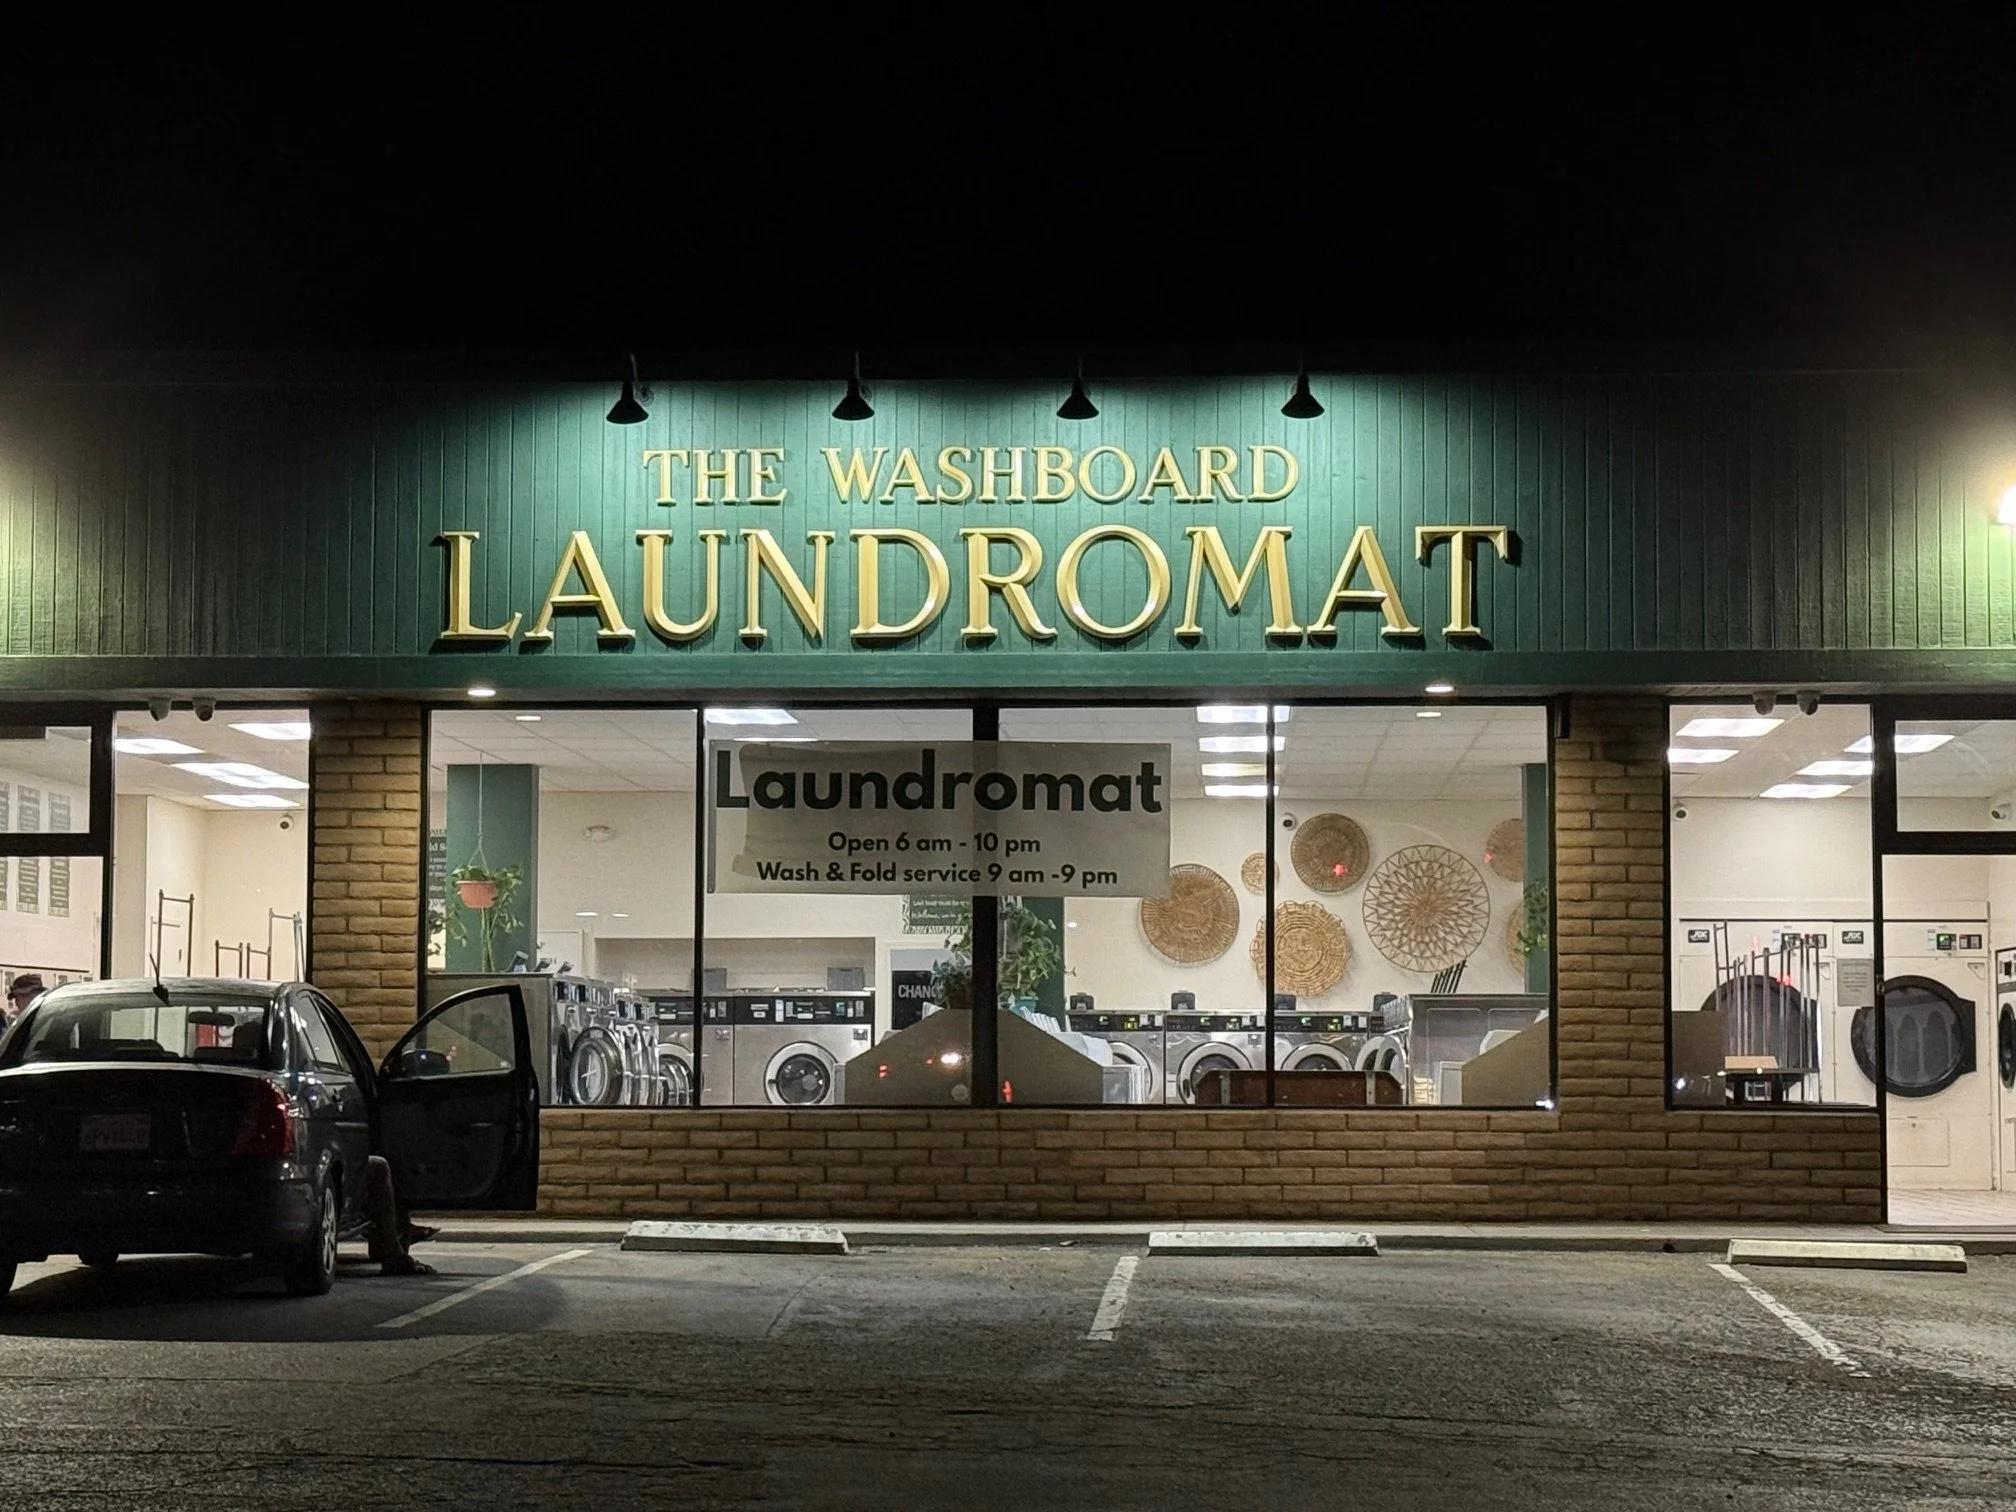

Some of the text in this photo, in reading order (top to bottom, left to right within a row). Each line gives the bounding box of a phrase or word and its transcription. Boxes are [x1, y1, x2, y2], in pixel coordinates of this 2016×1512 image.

[642, 446, 1300, 506] THE WASHBOARD
[438, 524, 1510, 642] LAUNDROMAT
[717, 749, 1163, 813] Laundromat
[828, 832, 889, 856] Open
[896, 832, 910, 851] 6
[917, 838, 952, 851] am
[974, 833, 998, 851] 10
[1005, 839, 1041, 857] pm
[757, 861, 819, 882] Wash
[826, 862, 845, 882] &
[851, 861, 897, 882] Fold
[903, 863, 981, 883] service
[988, 863, 1002, 882] 9
[1009, 871, 1044, 883] am
[1083, 871, 1118, 889] pm
